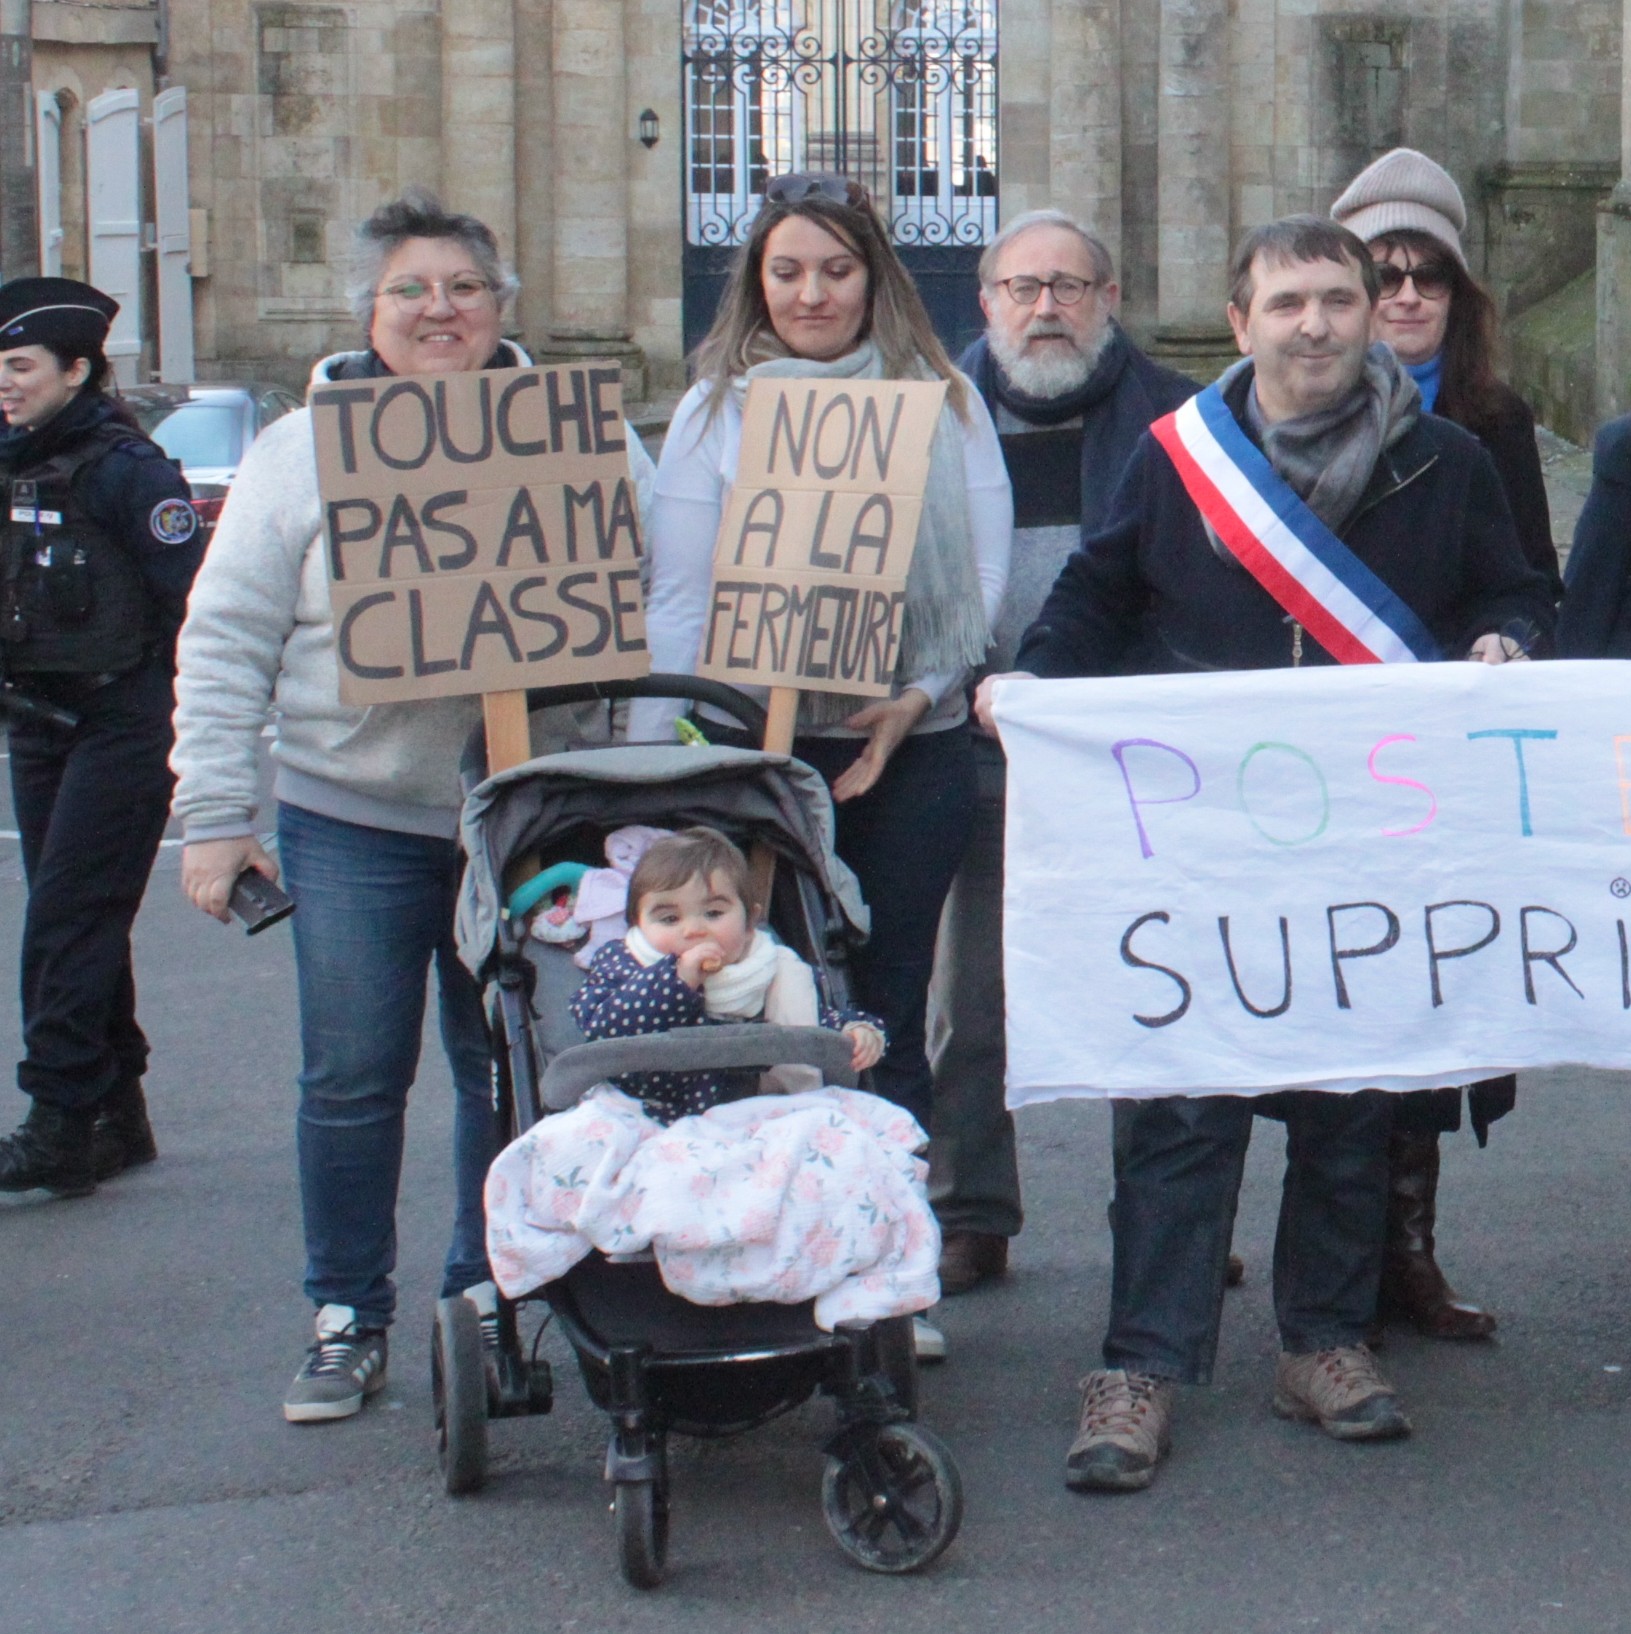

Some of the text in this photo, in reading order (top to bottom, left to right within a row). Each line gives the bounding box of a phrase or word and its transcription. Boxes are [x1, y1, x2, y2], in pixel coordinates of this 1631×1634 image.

[313, 368, 627, 474] TOUCHE
[768, 389, 905, 482] NON
[328, 477, 644, 581] PAS A MA
[734, 488, 893, 574] A LA
[339, 570, 647, 679] CLASSE
[704, 580, 905, 685] FERMETURE
